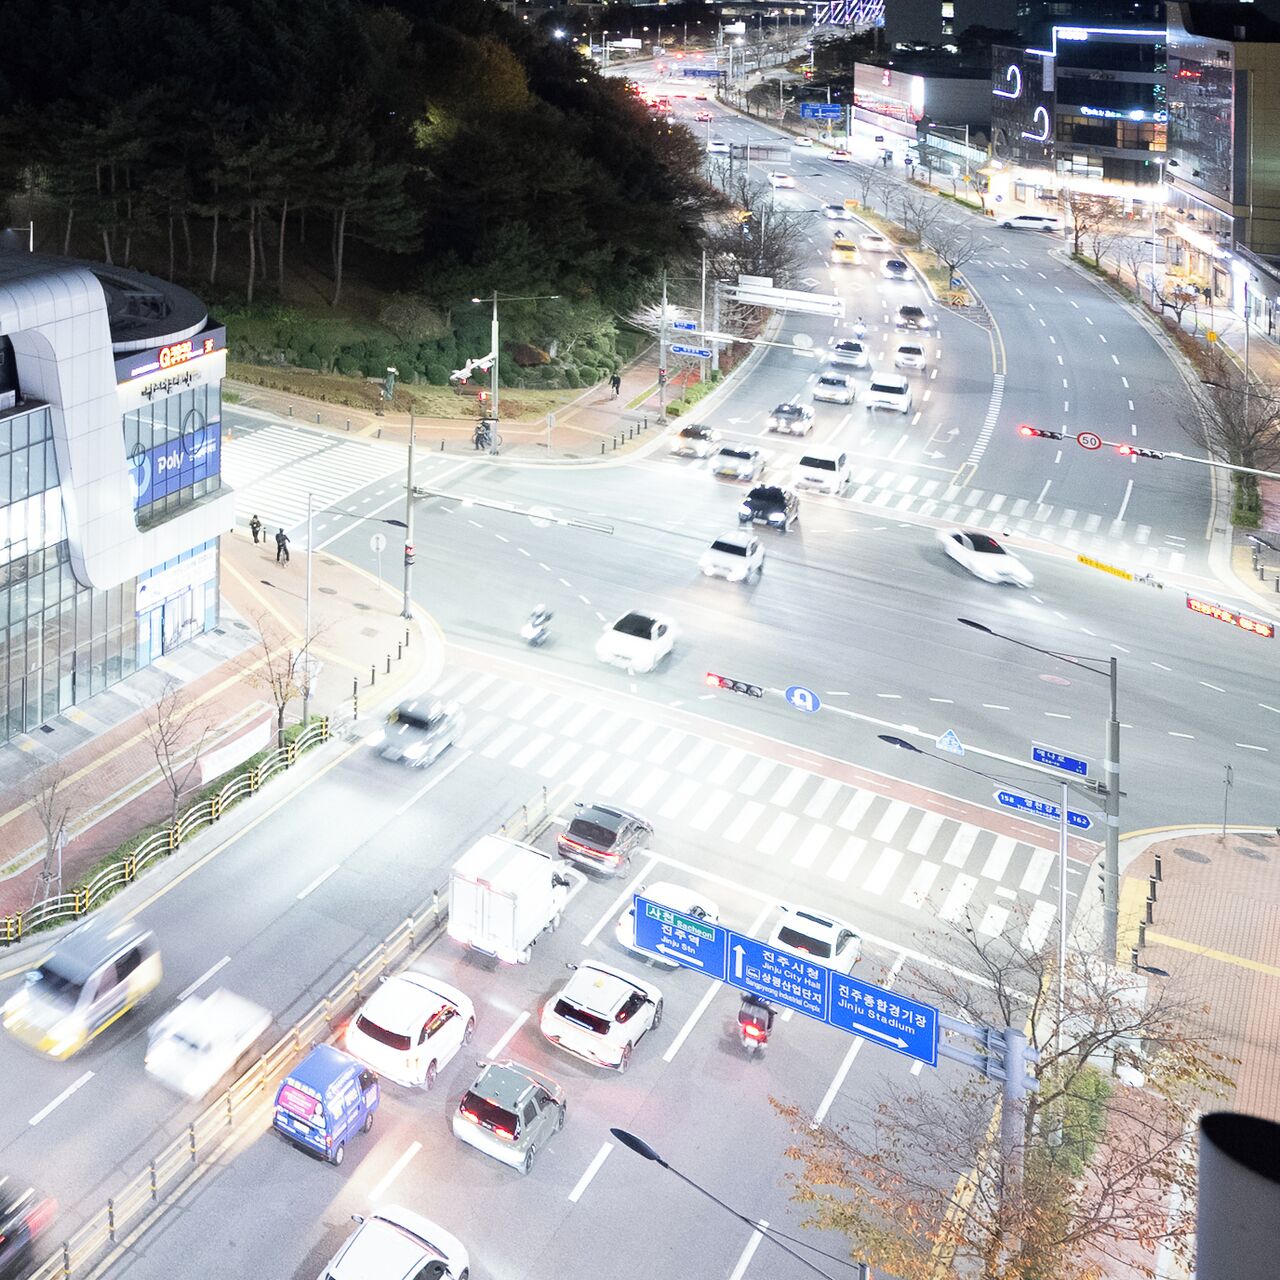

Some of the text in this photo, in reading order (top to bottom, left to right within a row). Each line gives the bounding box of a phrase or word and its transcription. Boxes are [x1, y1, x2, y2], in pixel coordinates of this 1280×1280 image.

[1082, 436, 1097, 446] 50
[1073, 815, 1087, 825] 162
[649, 907, 674, 924] 사천
[661, 924, 699, 948] 진주역
[676, 920, 713, 941] Sacheon
[660, 936, 696, 954] Jinju Stn
[762, 962, 821, 990] Jinju City Hall
[763, 950, 819, 980] 진주시청
[762, 973, 822, 1004] 상평산업단지
[838, 984, 927, 1028] 진주종합경기장
[838, 999, 916, 1035] Jinju Stadium
